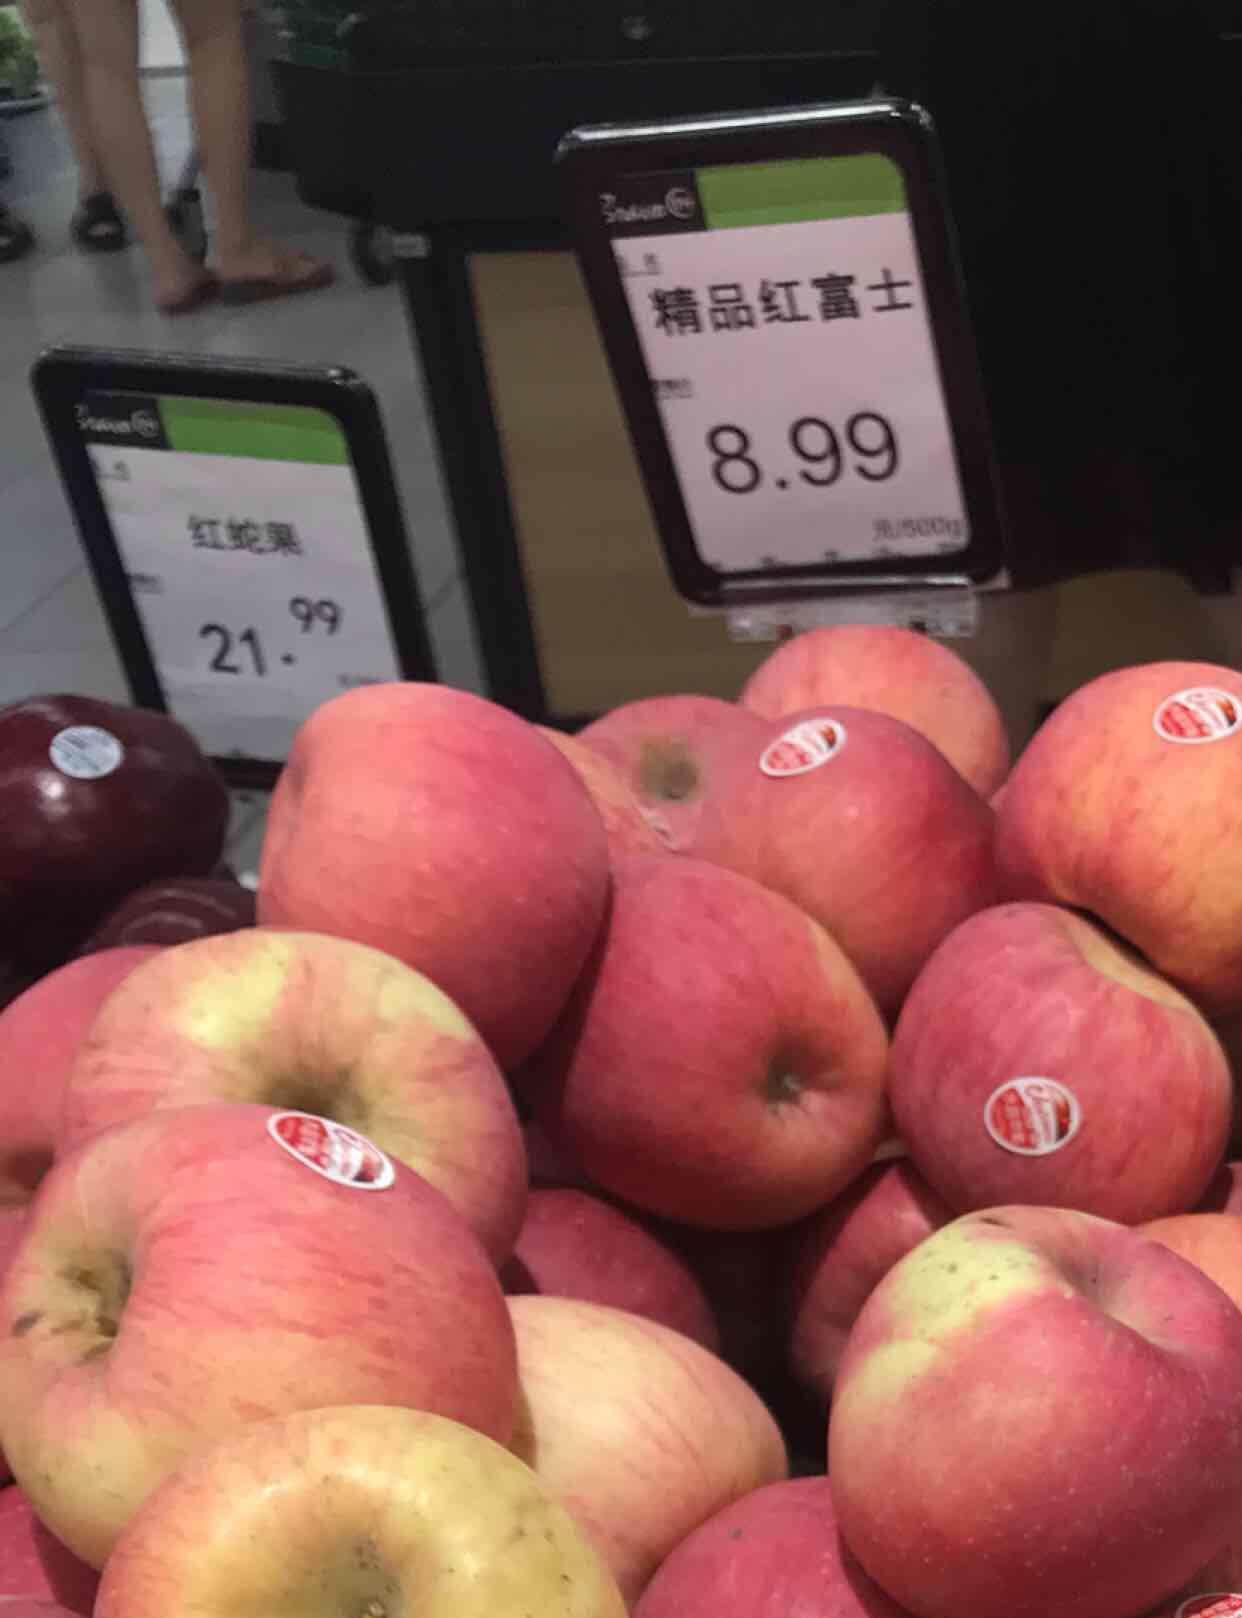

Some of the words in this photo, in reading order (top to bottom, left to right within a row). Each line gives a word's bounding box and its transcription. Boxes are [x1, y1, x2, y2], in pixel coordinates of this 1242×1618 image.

[648, 268, 914, 337] 精品红富士
[706, 411, 898, 494] 8.99
